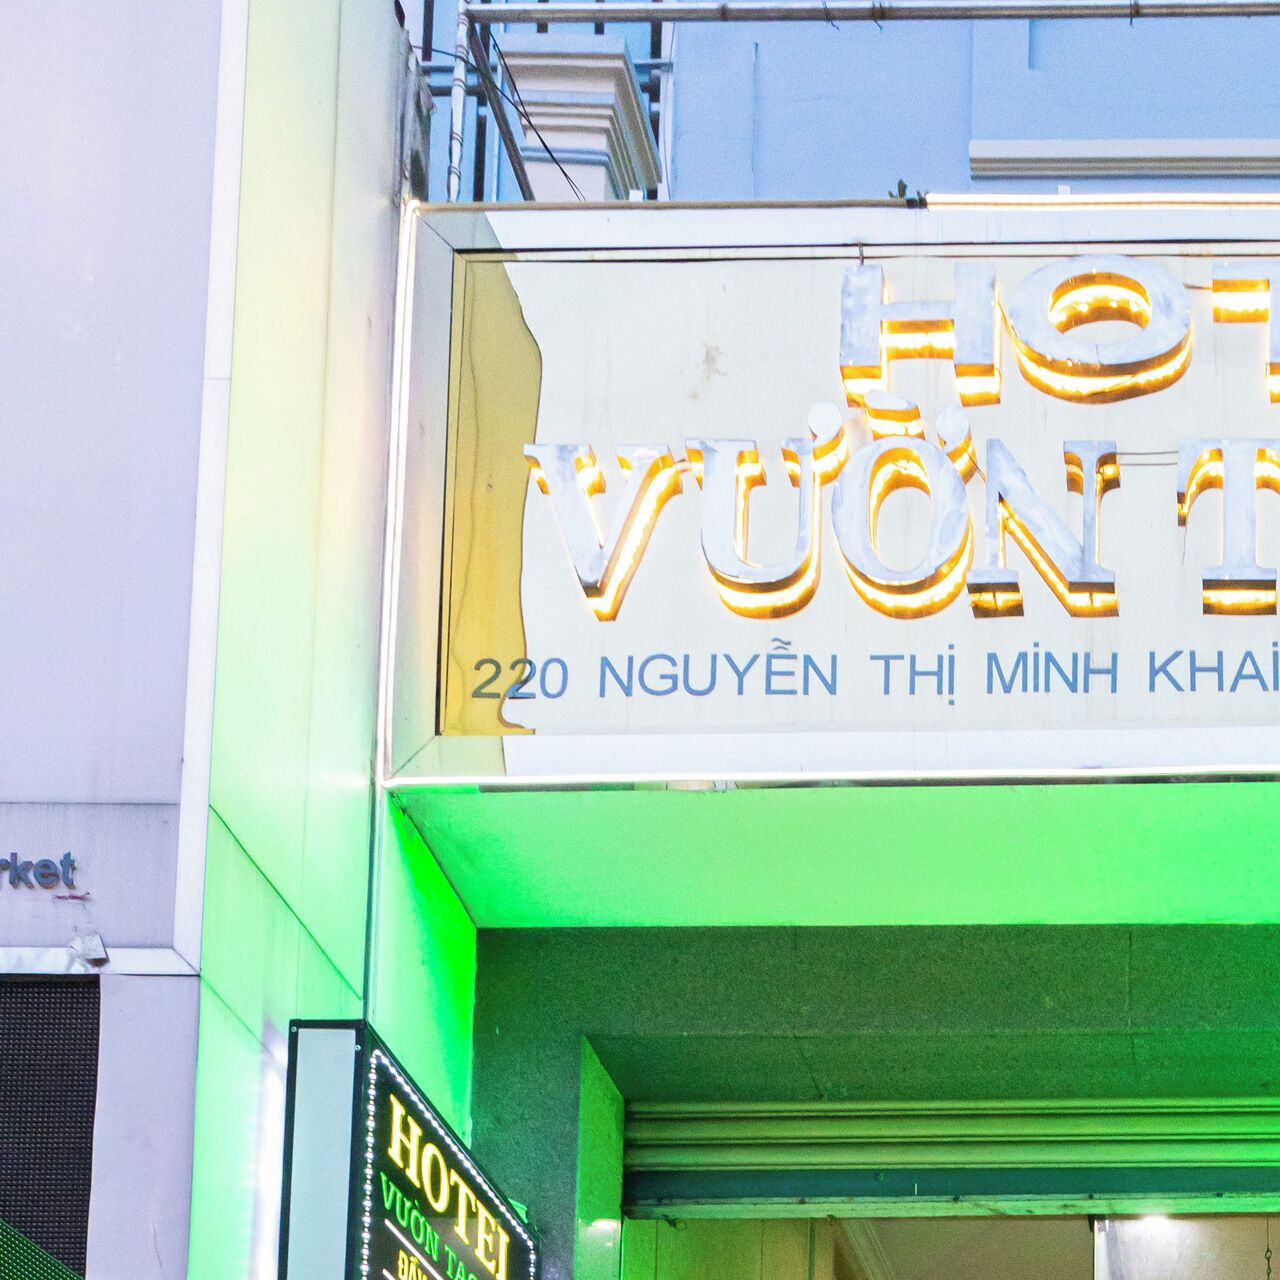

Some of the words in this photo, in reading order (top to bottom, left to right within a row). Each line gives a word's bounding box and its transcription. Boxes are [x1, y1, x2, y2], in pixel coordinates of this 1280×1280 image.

[524, 390, 1121, 622] VƯỜN
[472, 657, 568, 700] 220
[599, 637, 839, 697] NGUYỄN
[870, 643, 955, 706] THỊ
[380, 1171, 439, 1262] VƯỜN
